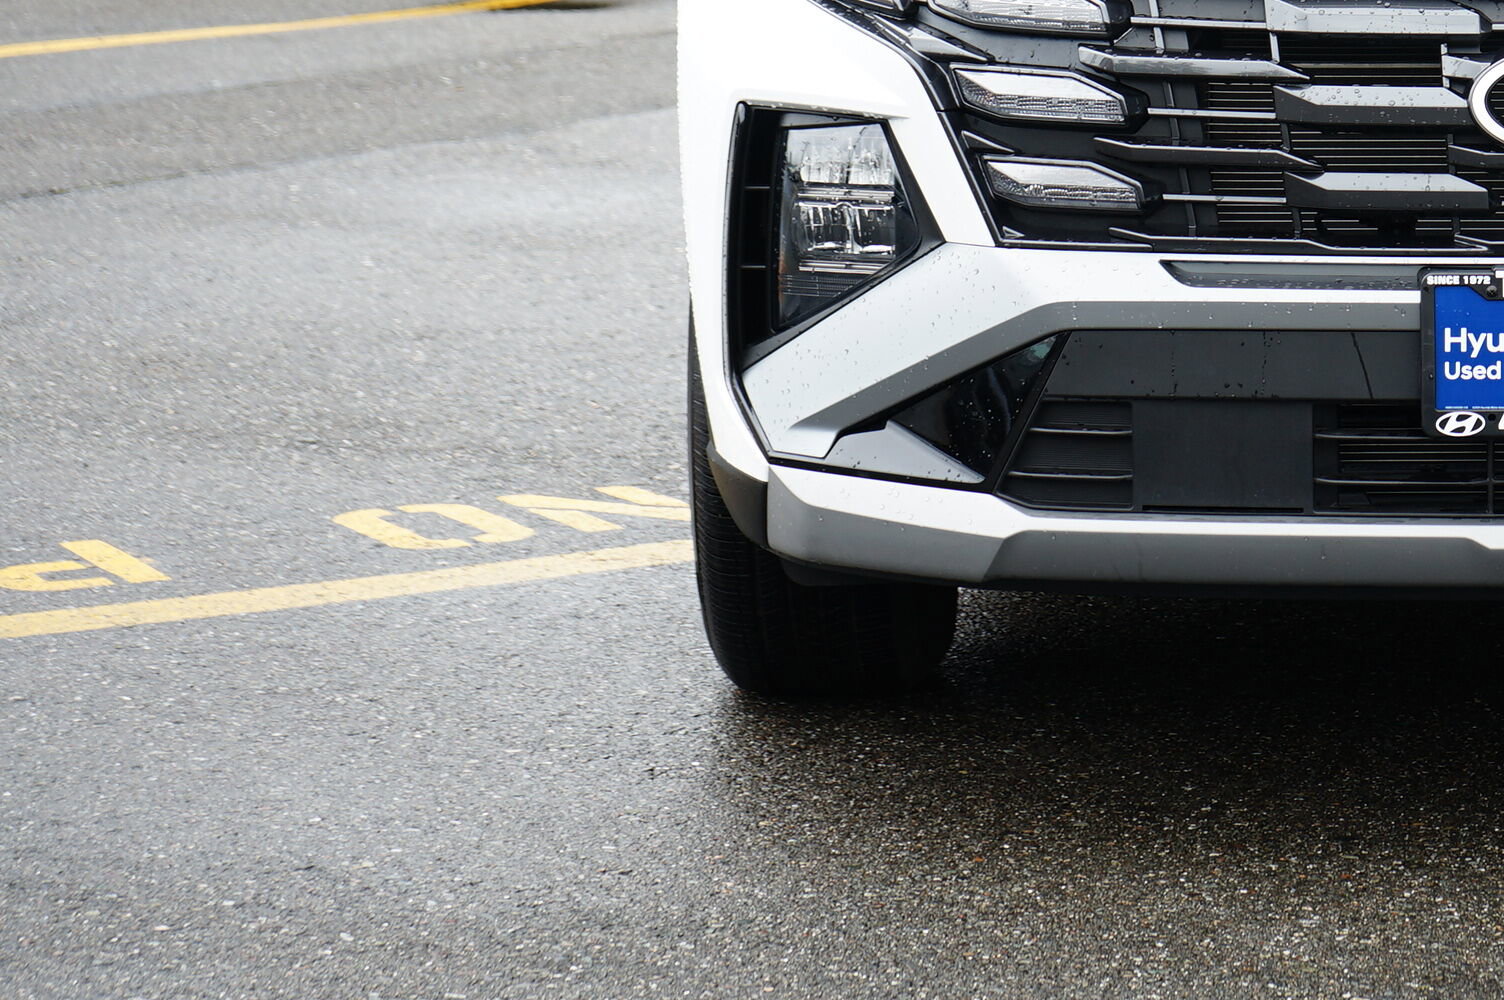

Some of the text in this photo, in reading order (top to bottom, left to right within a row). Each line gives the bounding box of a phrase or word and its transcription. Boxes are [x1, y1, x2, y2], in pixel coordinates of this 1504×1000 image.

[1426, 275, 1491, 285] SINCE 1972
[1444, 361, 1502, 380] Used
